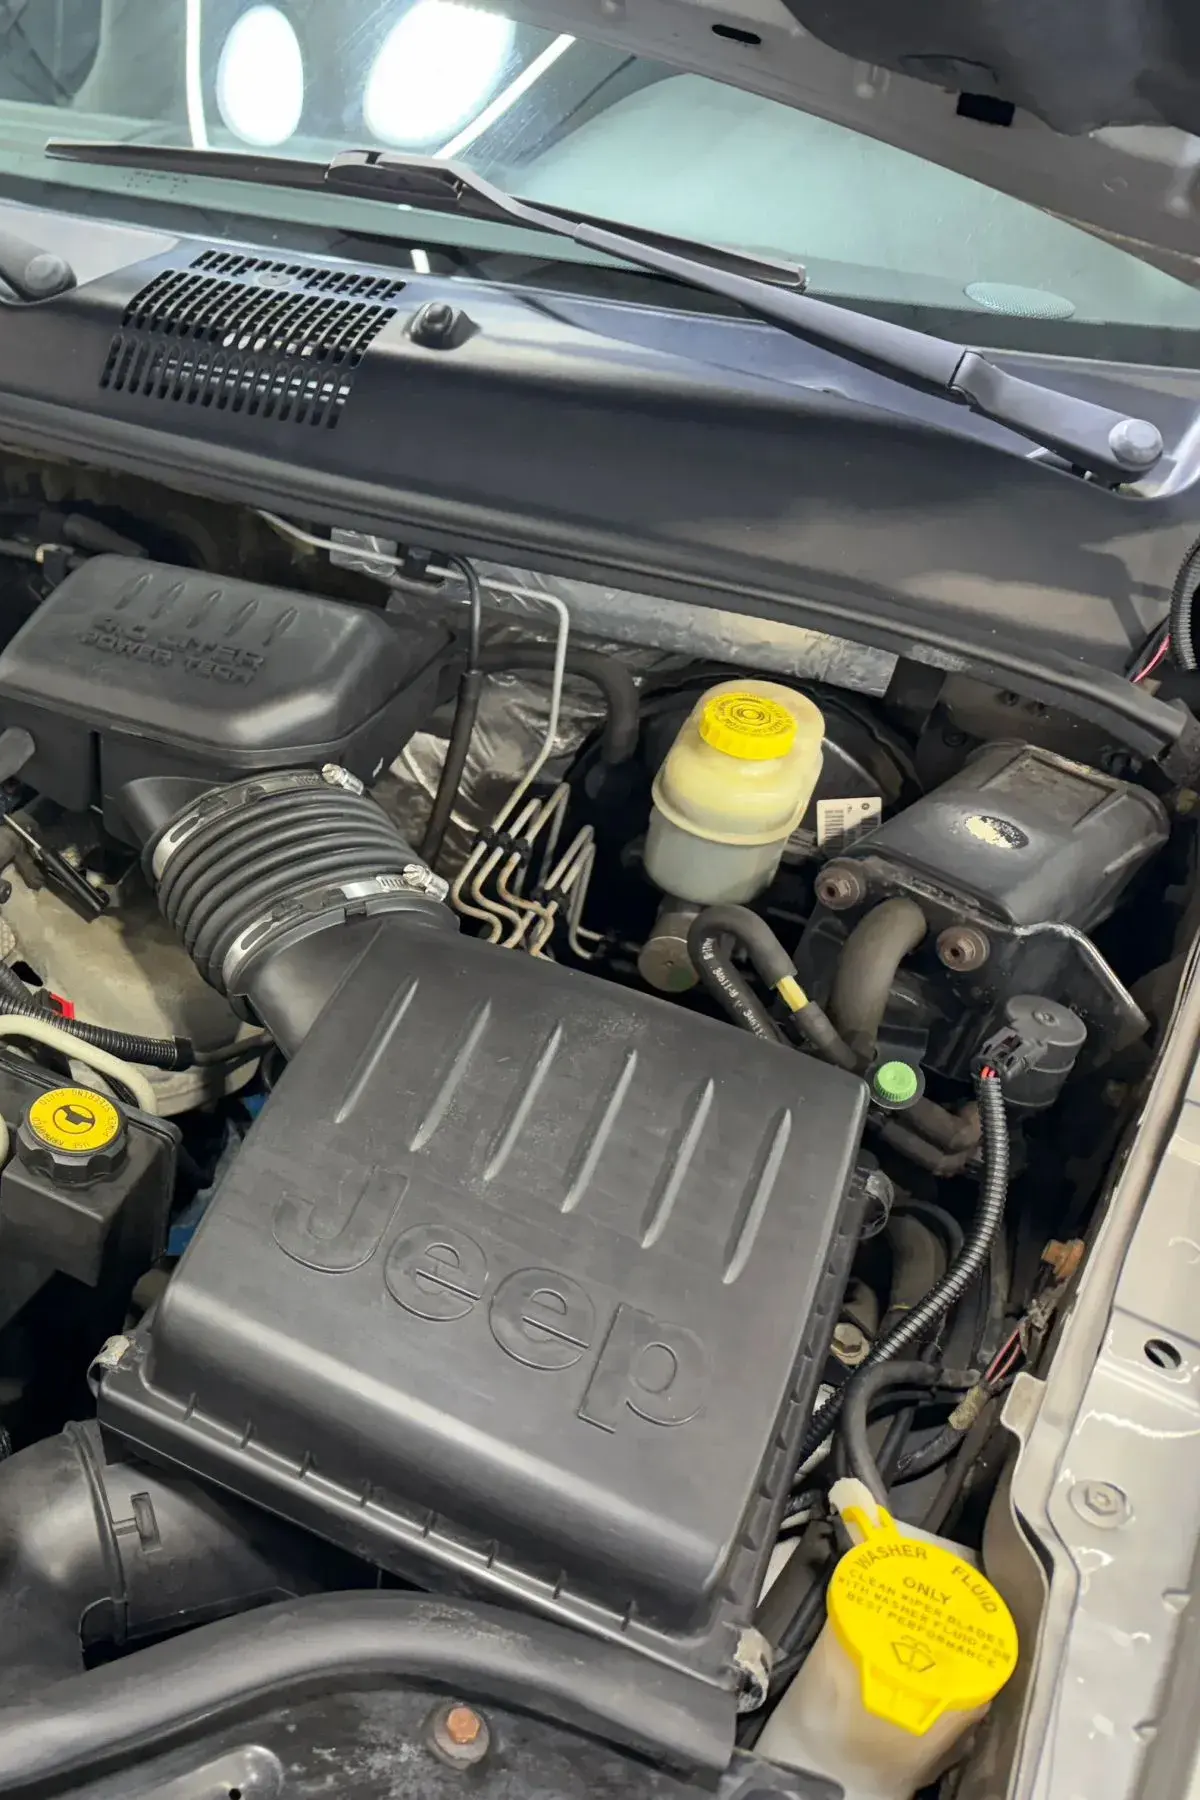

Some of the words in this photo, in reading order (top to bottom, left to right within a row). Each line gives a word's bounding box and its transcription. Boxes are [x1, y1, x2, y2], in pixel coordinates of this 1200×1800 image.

[71, 1089, 113, 1113] STEERING
[271, 1164, 713, 1434] Jeep
[849, 1568, 896, 1596] CLEAN
[901, 1594, 942, 1617] WIPER
[947, 1615, 1005, 1648] BLADES
[853, 1544, 928, 1570] WASHER
[951, 1565, 998, 1614] FLUID
[902, 1576, 952, 1605] ONLY
[846, 1590, 883, 1614] BEST
[887, 1611, 996, 1669] PERFORMANCE
[874, 1593, 928, 1624] WASHER
[933, 1620, 977, 1648] FLUID
